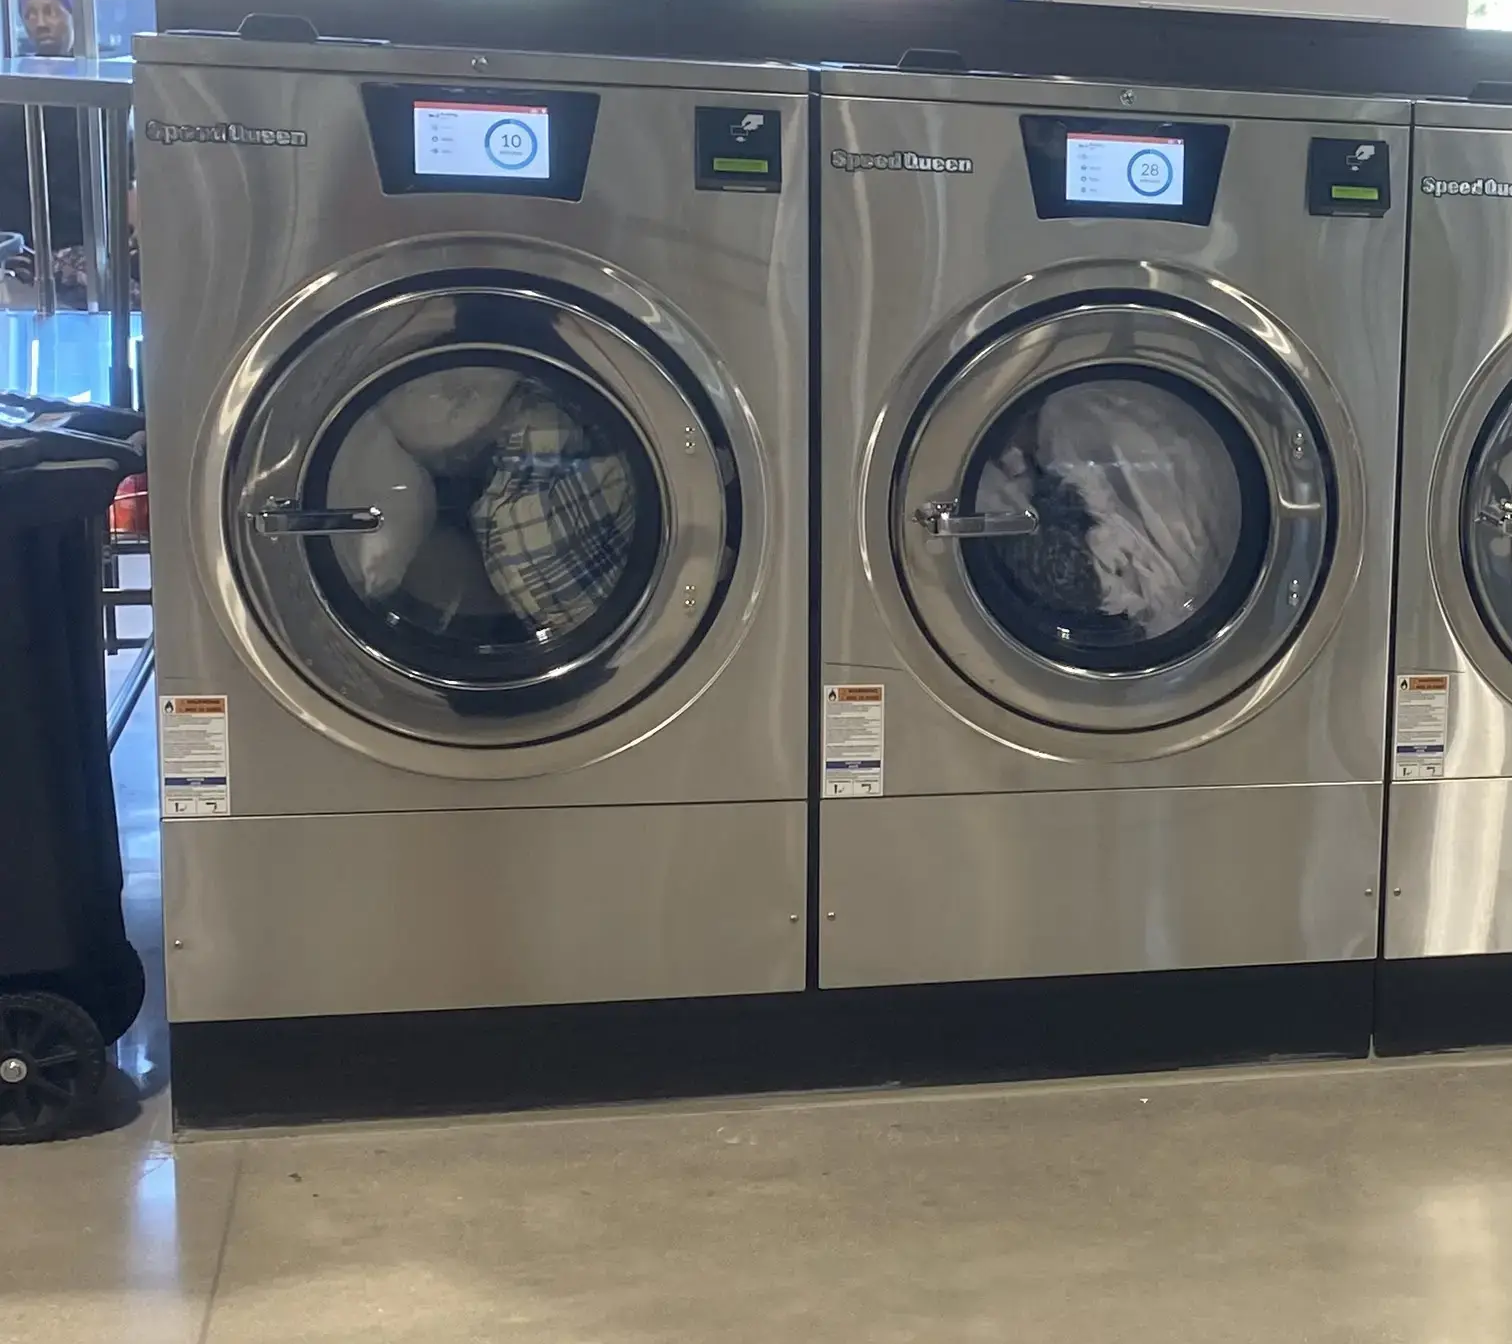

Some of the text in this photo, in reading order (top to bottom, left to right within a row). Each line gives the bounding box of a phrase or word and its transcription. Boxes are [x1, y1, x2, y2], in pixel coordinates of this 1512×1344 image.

[501, 134, 522, 148] 10
[831, 149, 974, 173] Speed Queen
[1141, 163, 1159, 176] 28
[1421, 176, 1483, 197] Speed
